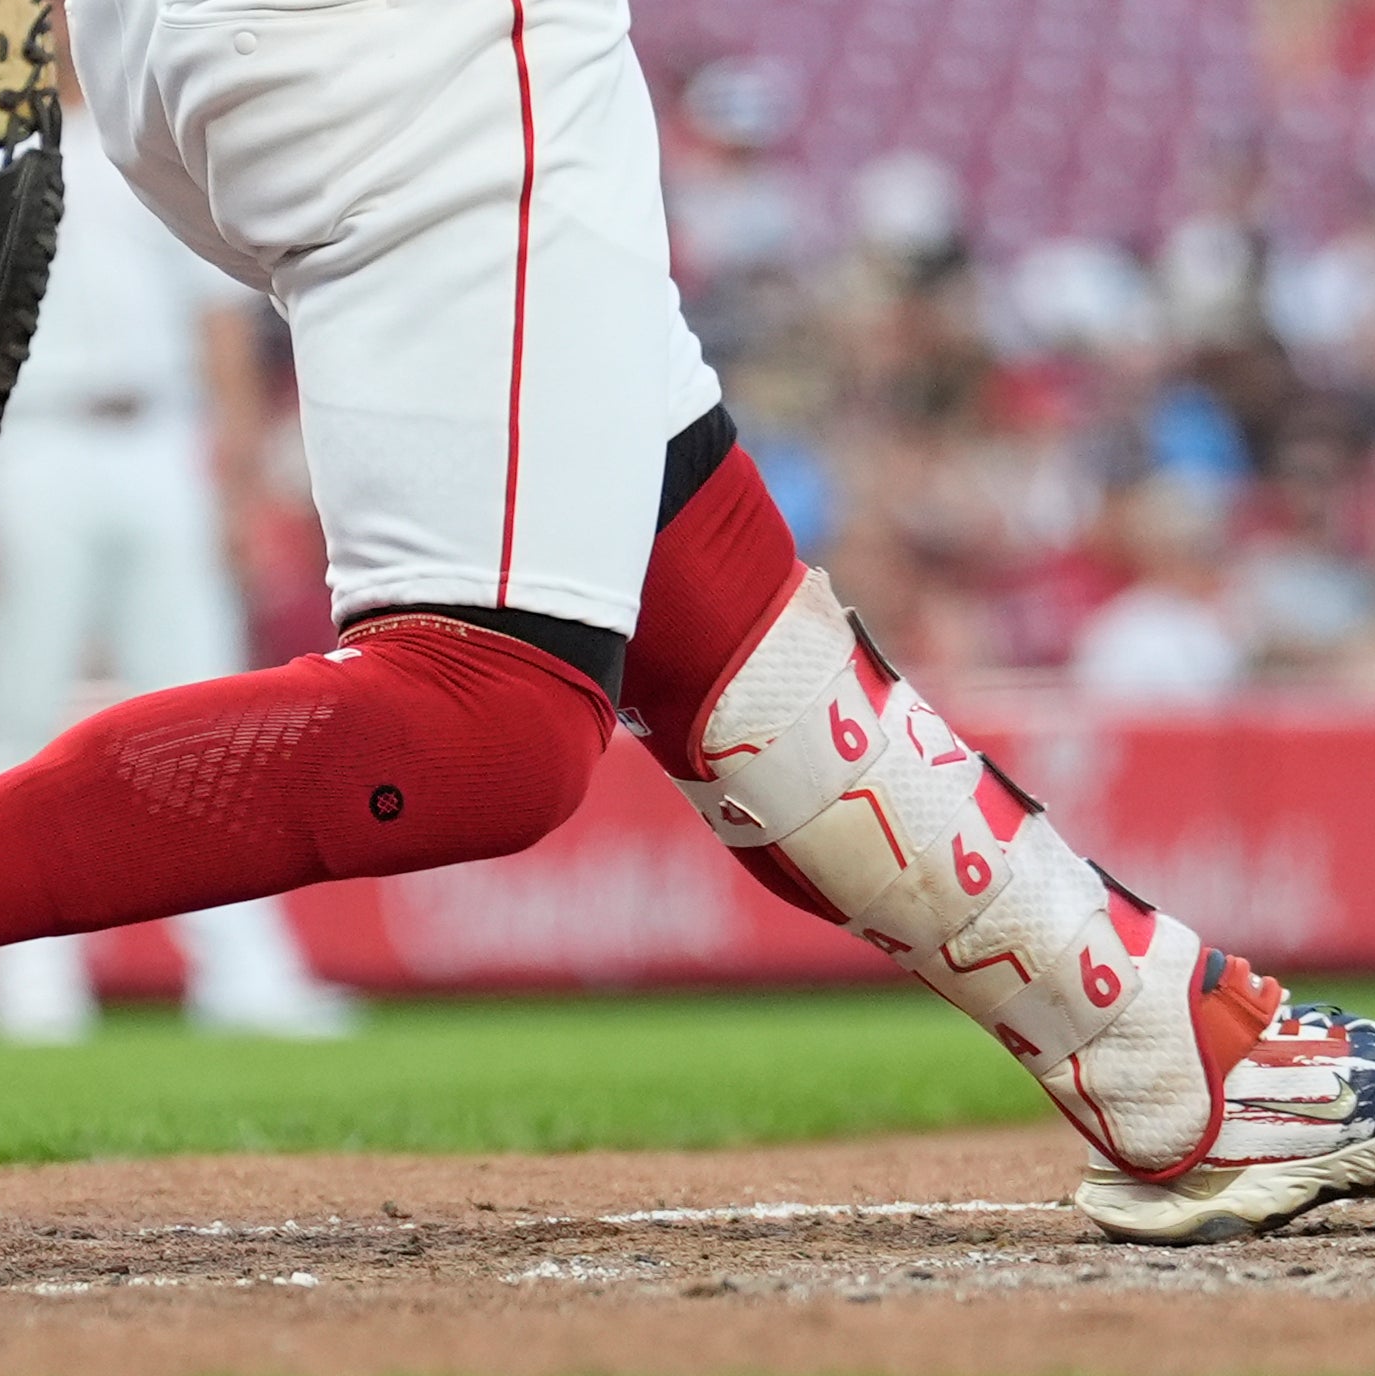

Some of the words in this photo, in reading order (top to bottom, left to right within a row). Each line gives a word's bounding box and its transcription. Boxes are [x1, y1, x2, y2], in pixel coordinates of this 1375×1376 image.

[828, 698, 869, 763] 6
[950, 831, 993, 897] 6
[1078, 944, 1122, 1009] 6
